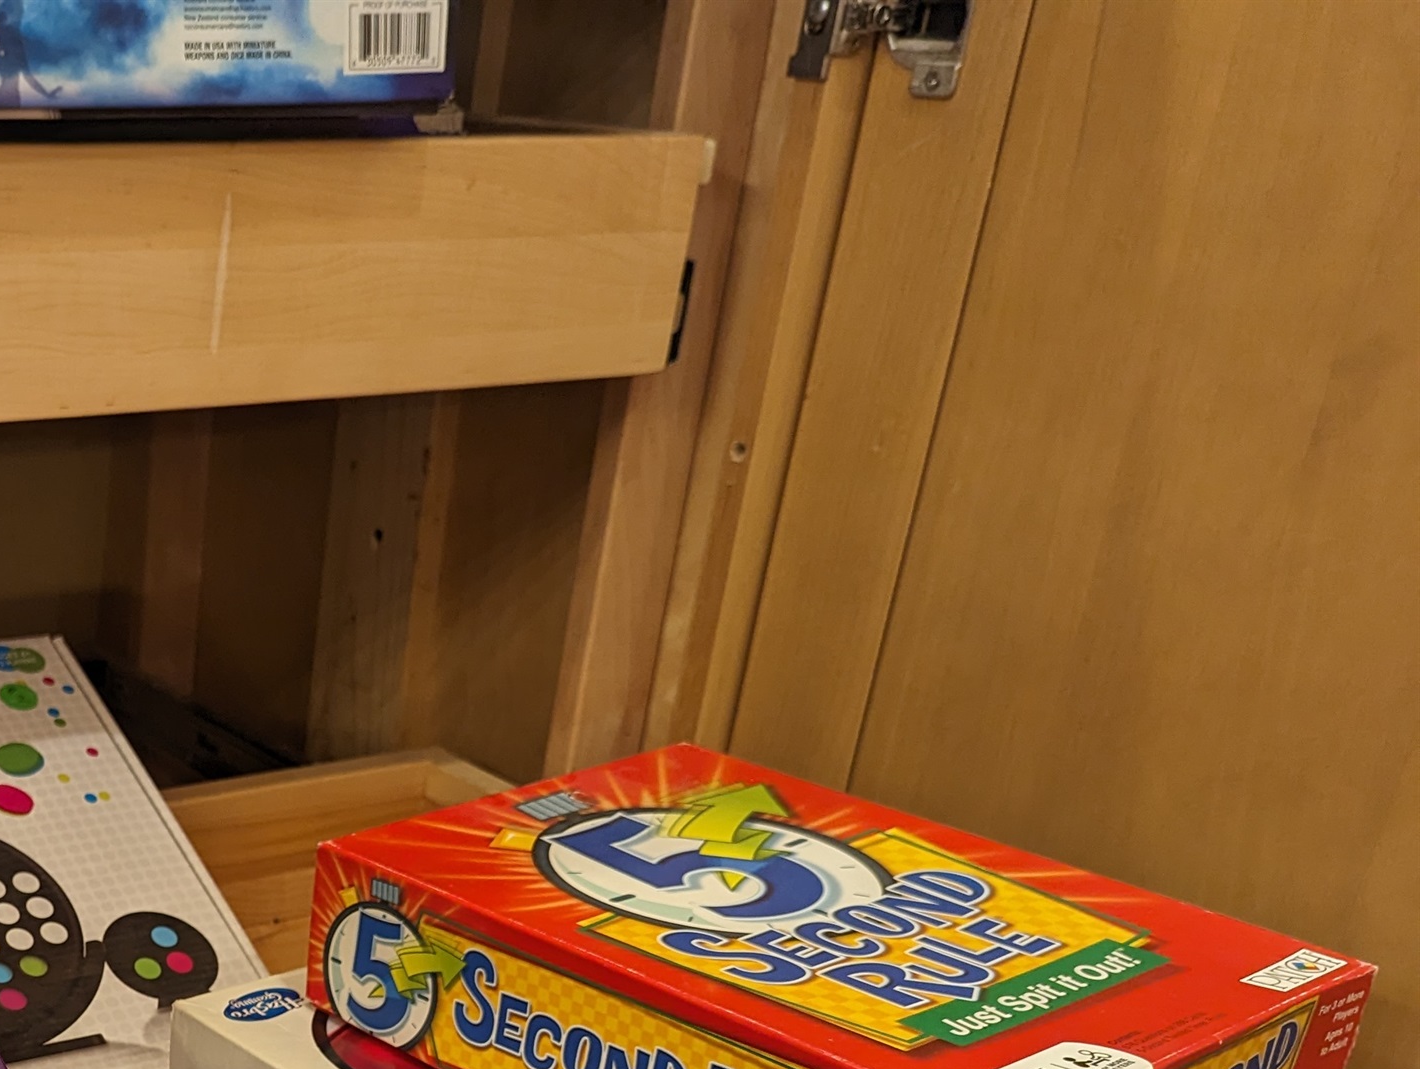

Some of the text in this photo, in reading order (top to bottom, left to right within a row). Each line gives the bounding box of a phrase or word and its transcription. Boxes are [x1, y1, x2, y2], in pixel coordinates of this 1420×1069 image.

[184, 41, 203, 51] MADE
[212, 41, 224, 50] USA
[184, 51, 263, 60] WEAPONS AND MADE
[562, 815, 826, 922] 5
[661, 866, 993, 986] SECOND
[346, 907, 414, 1031] 5
[820, 912, 1063, 1010] RULE
[1248, 951, 1341, 990] PATCH
[230, 996, 303, 1018] Hasbro
[941, 1004, 1013, 1037] Just
[996, 981, 1068, 1012] Spit
[1048, 973, 1089, 991] it
[1318, 990, 1365, 1016] For 3 or More
[1332, 1004, 1360, 1023] Players
[1320, 1036, 1349, 1056] to Adult
[1324, 1028, 1341, 1042] Ages
